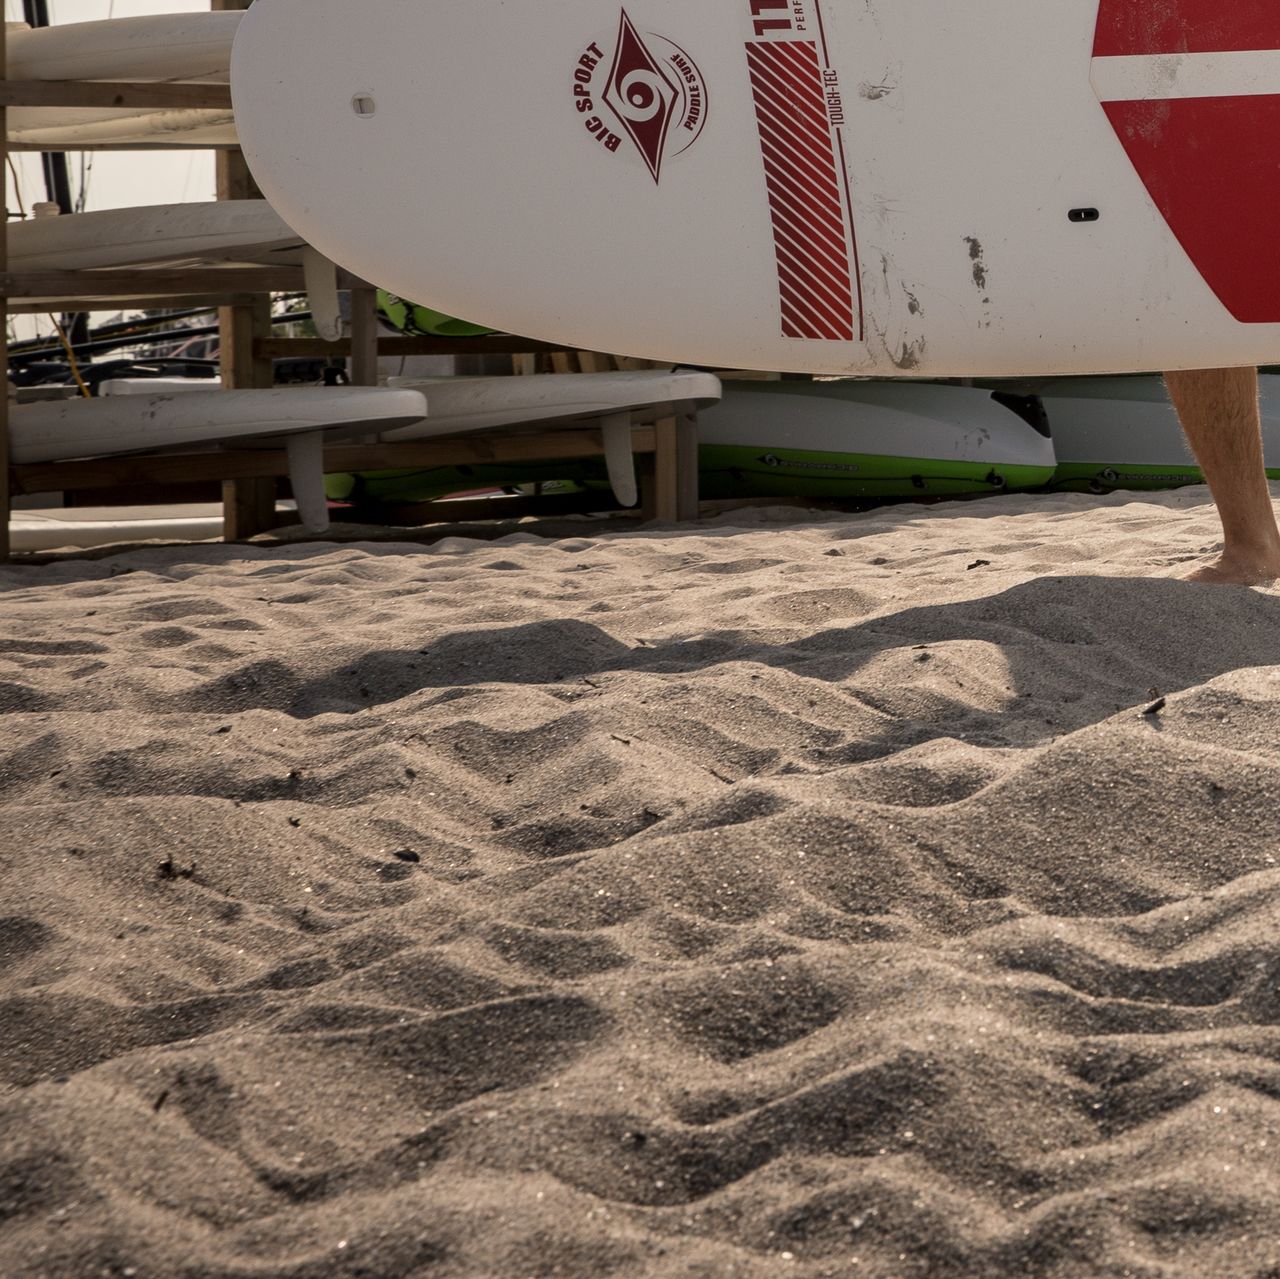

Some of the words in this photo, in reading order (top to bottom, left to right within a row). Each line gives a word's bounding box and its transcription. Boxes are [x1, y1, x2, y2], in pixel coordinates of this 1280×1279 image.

[573, 41, 604, 113] SPORT
[670, 53, 696, 84] SURF
[683, 84, 701, 131] PADDLE
[823, 70, 845, 126] TOUGH-TEC
[585, 116, 622, 152] BIC
